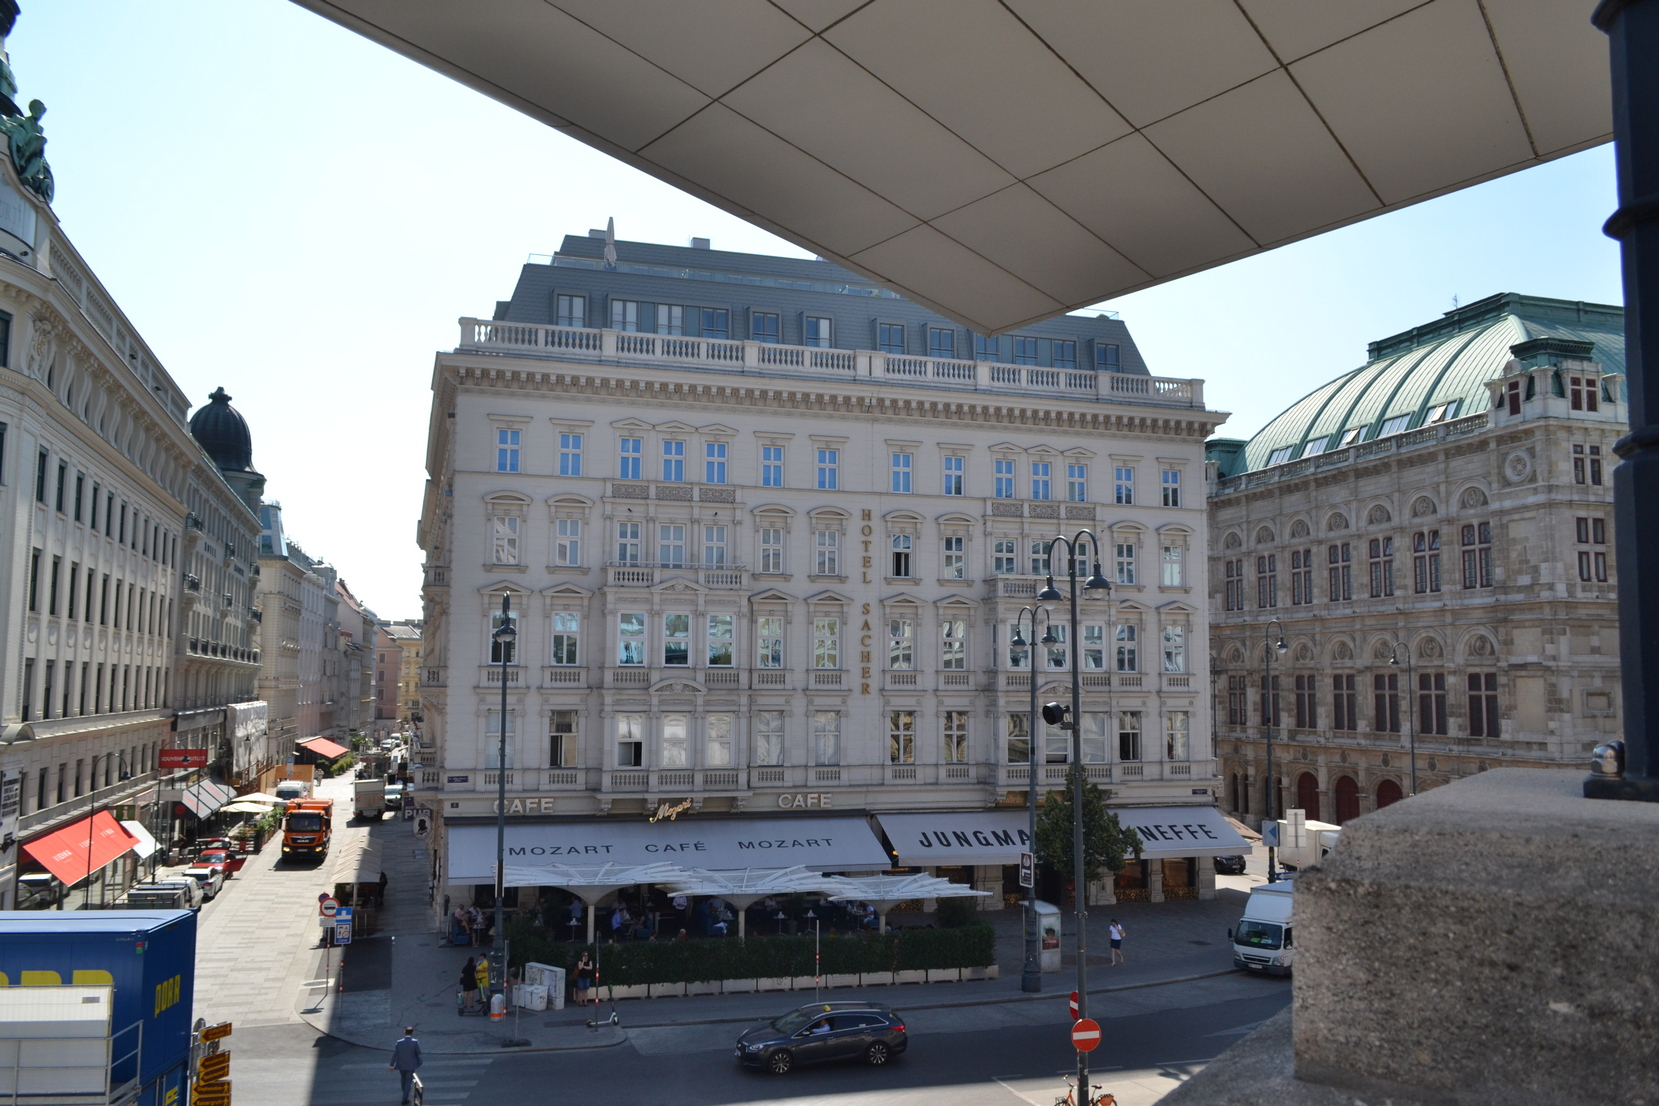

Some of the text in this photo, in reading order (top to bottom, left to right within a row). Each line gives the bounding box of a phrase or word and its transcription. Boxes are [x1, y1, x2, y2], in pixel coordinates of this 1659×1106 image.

[860, 508, 873, 695] HOTEL SACHER
[649, 797, 692, 823] Mozart
[778, 794, 832, 808] CAFE
[918, 829, 1031, 848] JUNGMA
[1136, 823, 1219, 841] NEFFE
[508, 838, 834, 856] MOZART CAFÉ MOZART
